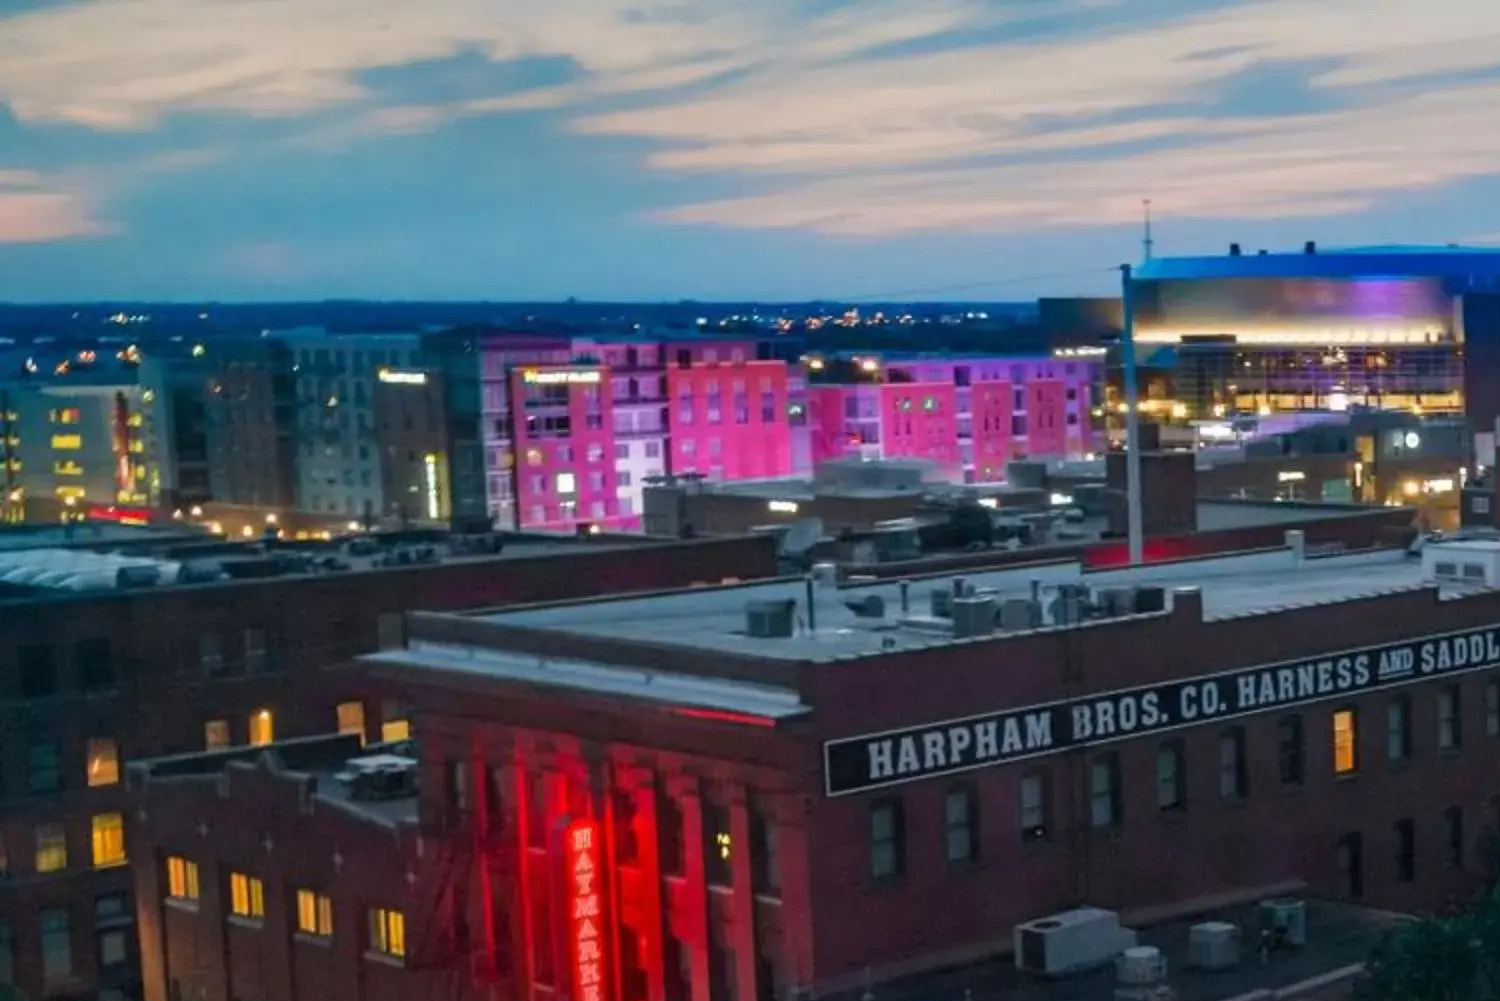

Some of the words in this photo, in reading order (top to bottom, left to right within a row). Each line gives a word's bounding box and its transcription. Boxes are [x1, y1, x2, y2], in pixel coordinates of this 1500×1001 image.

[868, 709, 1053, 780] HARPHAM
[1072, 693, 1169, 740] BROS.
[1181, 681, 1227, 719] CO.
[1238, 656, 1370, 708] HARNESS
[1378, 646, 1414, 675] AND
